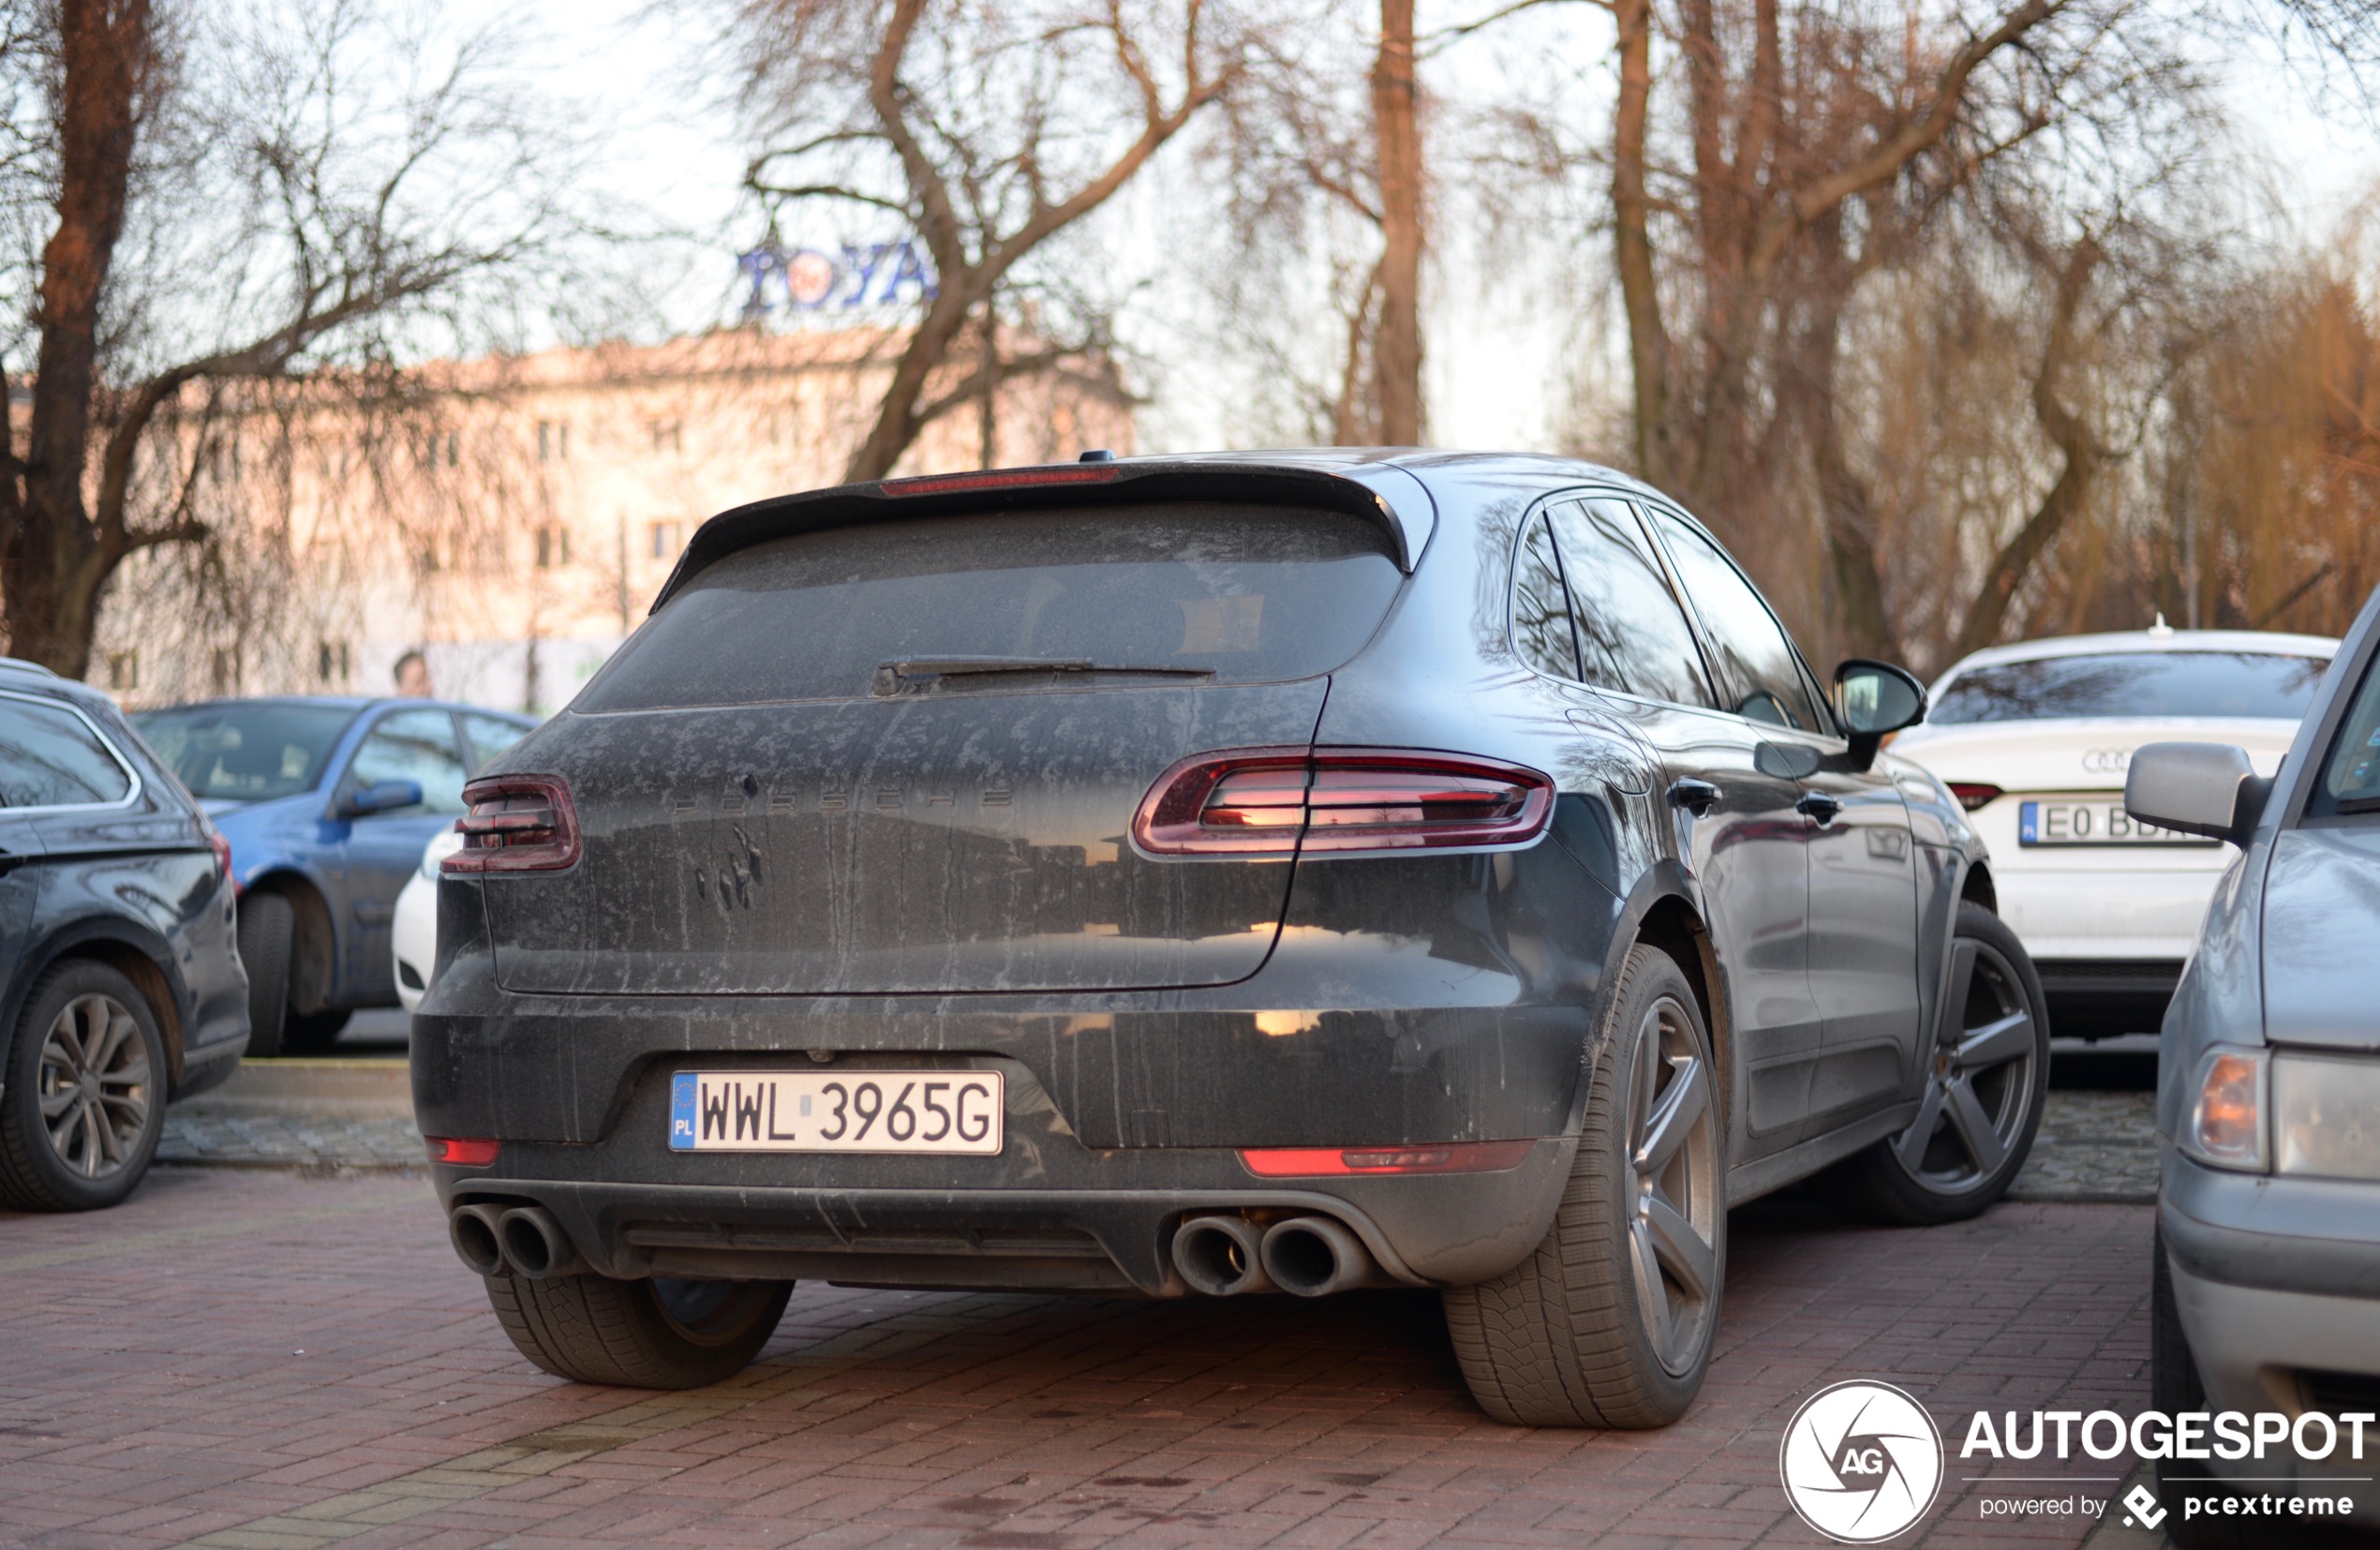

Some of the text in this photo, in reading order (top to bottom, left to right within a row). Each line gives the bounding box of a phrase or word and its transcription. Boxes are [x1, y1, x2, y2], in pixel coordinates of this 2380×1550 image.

[675, 1120, 693, 1136] PL
[701, 1081, 990, 1142] WWL 3965G
